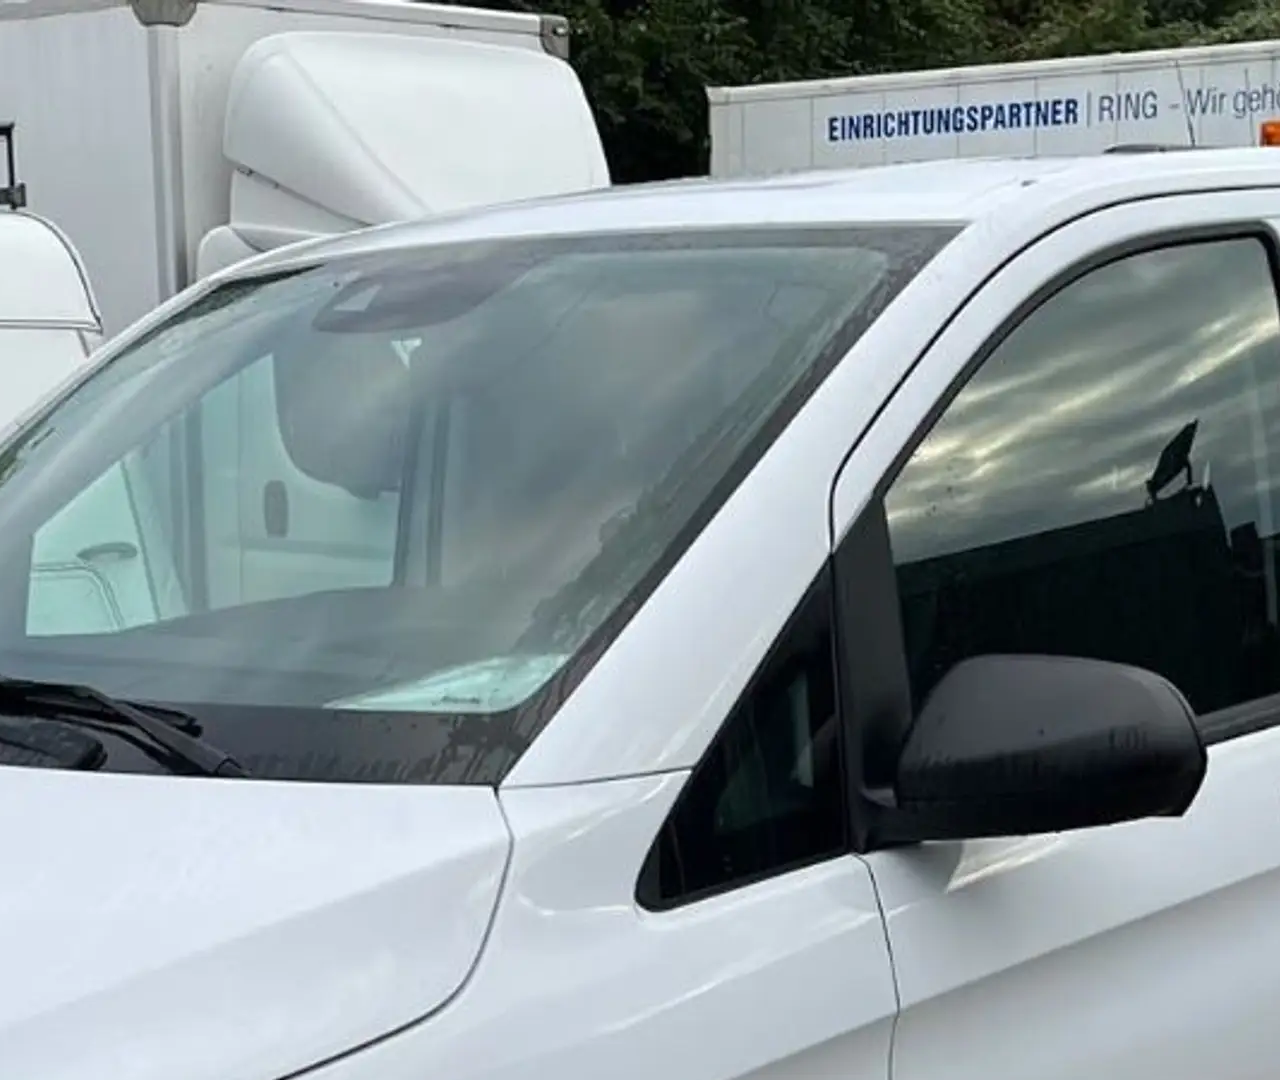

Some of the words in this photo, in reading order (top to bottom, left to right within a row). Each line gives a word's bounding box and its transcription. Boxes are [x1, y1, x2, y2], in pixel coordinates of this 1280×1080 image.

[827, 98, 1079, 142] EINRICHTUNGSPARTNER
[1098, 90, 1159, 122] RING
[1186, 86, 1228, 116] Wir
